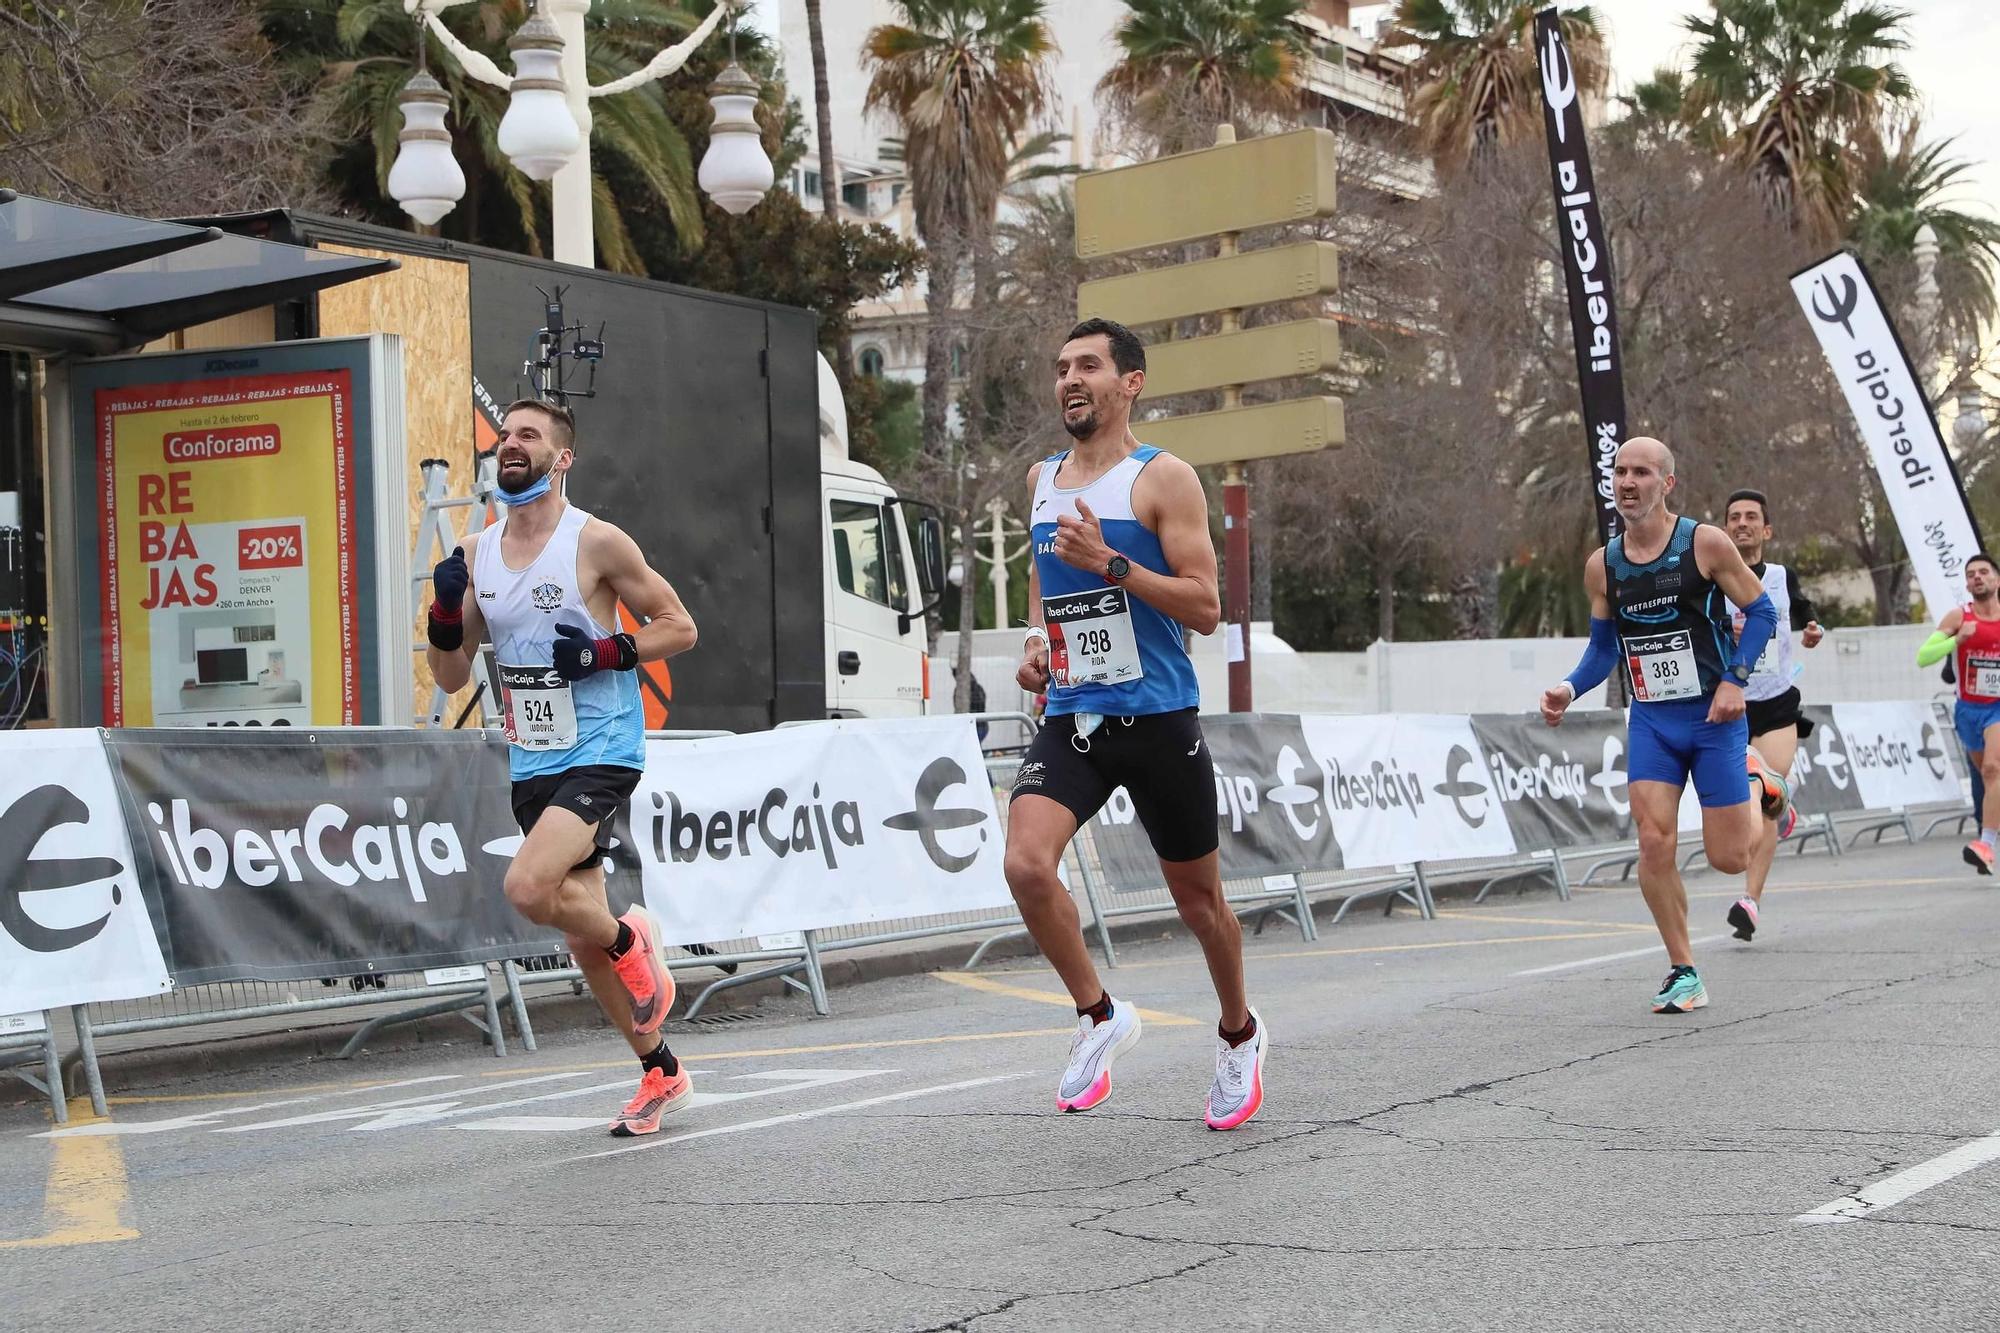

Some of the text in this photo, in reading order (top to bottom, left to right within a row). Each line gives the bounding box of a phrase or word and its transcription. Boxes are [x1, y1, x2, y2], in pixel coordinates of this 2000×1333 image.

[1558, 160, 1612, 372] iberCaja
[111, 382, 333, 412] REBAJAS REBAJAS REBAJAS REBAJAS REBAJAS
[334, 393, 344, 439] REBAJAS
[104, 414, 113, 458] REBAJAS
[180, 413, 259, 428] Hasta el 2 de febrero
[169, 434, 275, 458] Conforama
[105, 466, 114, 509] REBAJAS
[337, 446, 346, 491] REBAJAS
[107, 517, 115, 560] REBAJAS
[339, 499, 348, 545] REBAJAS
[242, 536, 297, 561] -20%
[109, 568, 117, 612] REBAJAS
[239, 575, 270, 585] Compacto
[239, 586, 271, 594] DENVER
[341, 551, 349, 597] REBAJAS
[246, 599, 269, 607] Ancho
[1047, 602, 1090, 617] iberCaja
[111, 619, 120, 663] REBAJAS
[342, 605, 351, 651] REBAJAS
[1077, 629, 1112, 656] 298
[1630, 642, 1663, 651] iberCaja
[1091, 656, 1107, 666] RIDA
[1652, 660, 1680, 679] 383
[112, 670, 121, 713] REBAJAS
[524, 700, 554, 721] 524
[530, 724, 555, 732] LUDOVIC
[1847, 732, 1912, 775] iberCaja
[1326, 757, 1425, 819] iberCaja
[1490, 750, 1588, 808] iberCaja
[652, 781, 864, 870] iberCaja
[148, 797, 468, 902] iberCaja
